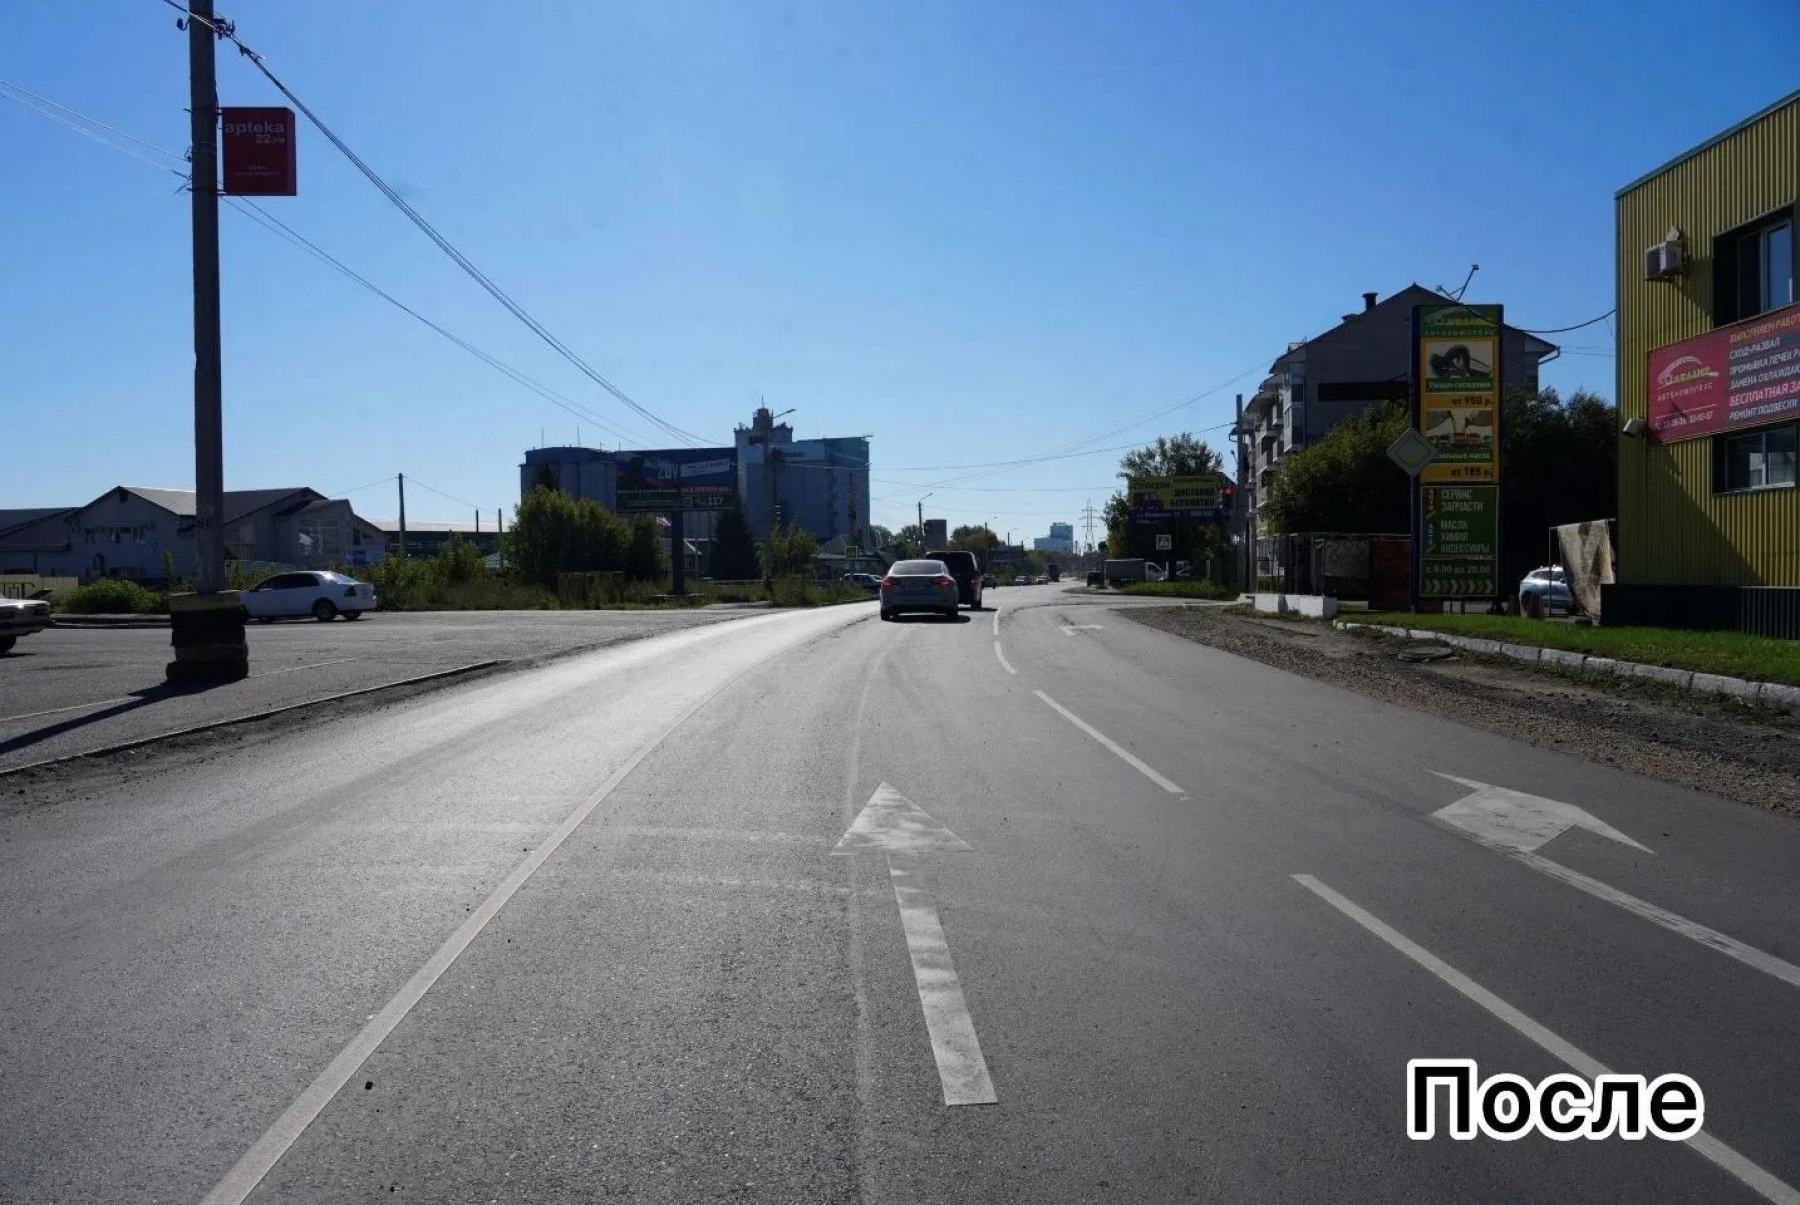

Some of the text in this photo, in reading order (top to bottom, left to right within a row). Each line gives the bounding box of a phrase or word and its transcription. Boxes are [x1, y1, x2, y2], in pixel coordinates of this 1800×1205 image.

[227, 121, 285, 137] apteka
[1729, 337, 1780, 360] СХОД-РАЗВАЛ
[1729, 383, 1789, 407] БЕСПЛАТНАЯ
[1729, 405, 1758, 421] РЕМОНТ
[1441, 489, 1473, 501] СЕРВИС
[1441, 501, 1484, 512] ЗАПЧАСТИ
[1440, 520, 1469, 531] МАСЛА
[1440, 531, 1468, 542] ХИМИЯ
[1440, 542, 1490, 554] АКСЕССУАРЫ
